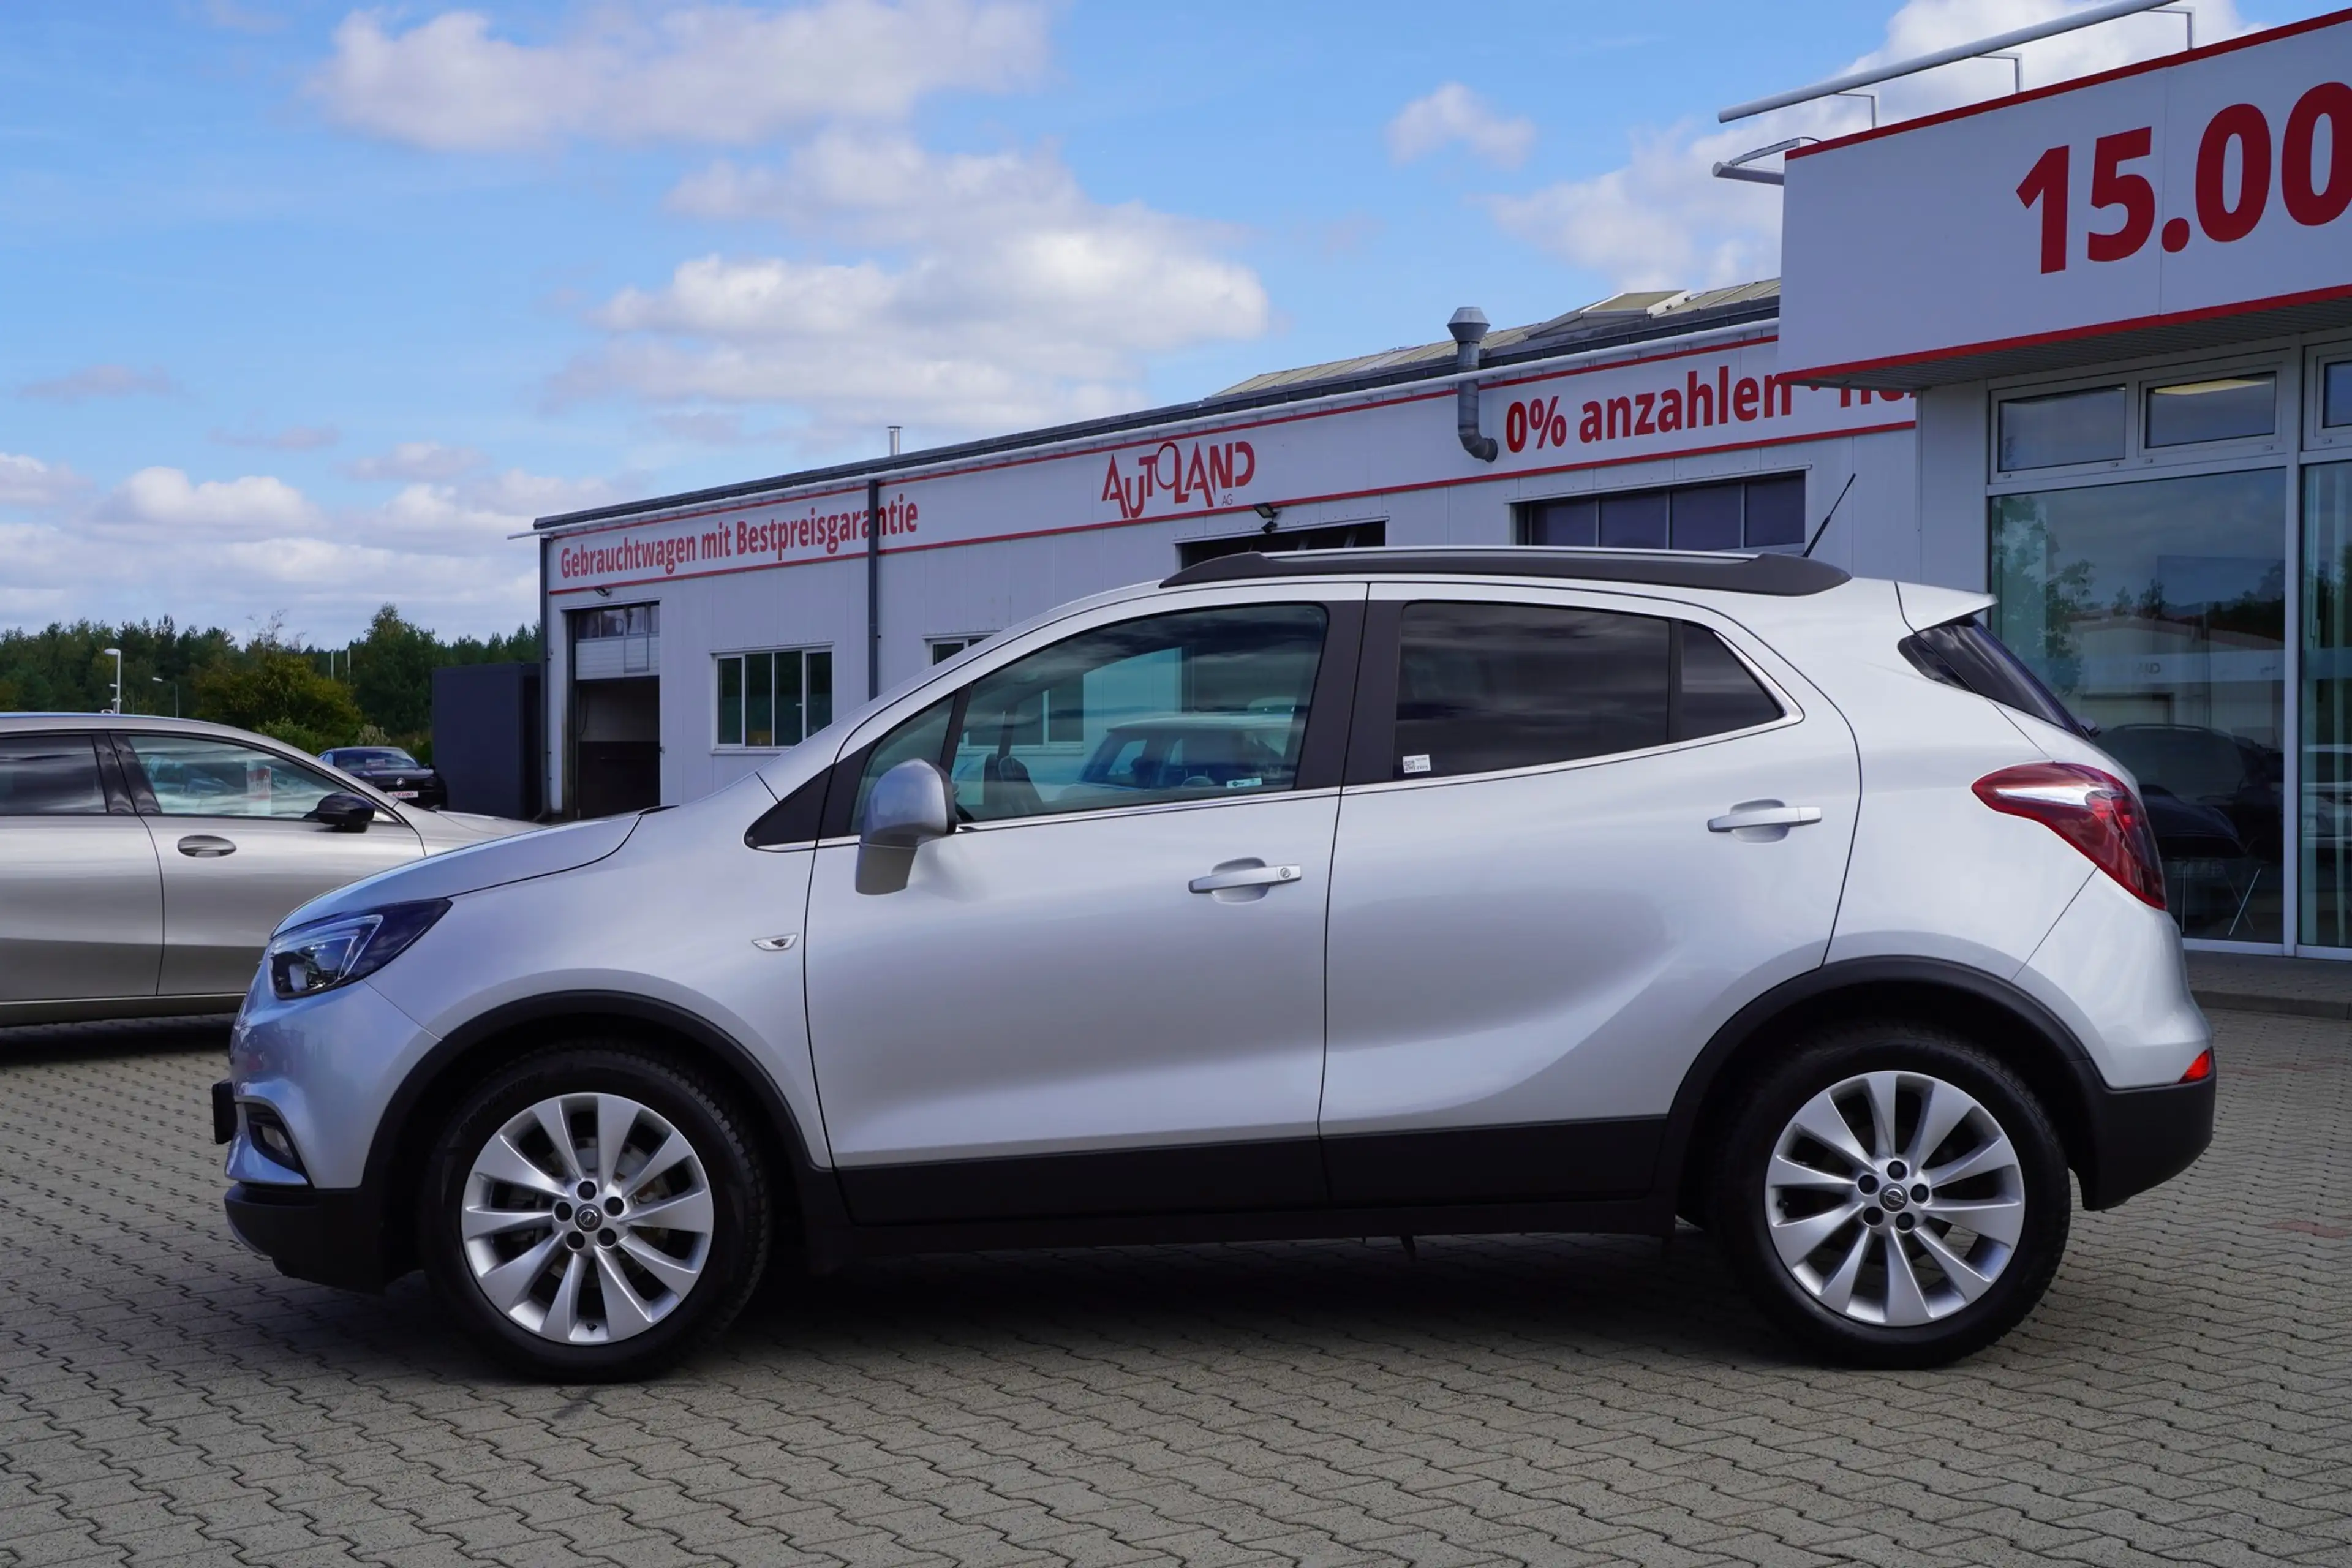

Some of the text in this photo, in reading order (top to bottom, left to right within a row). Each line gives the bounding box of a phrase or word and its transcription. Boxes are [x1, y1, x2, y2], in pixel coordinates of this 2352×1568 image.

[2016, 82, 2352, 274] 15.00
[1506, 366, 1792, 453] 0% anzahlen
[1102, 440, 1256, 519] AUTOLAND
[1221, 493, 1234, 506] AG
[561, 493, 918, 578] Gebrauchtwagen mit Bestpreisgarantie
